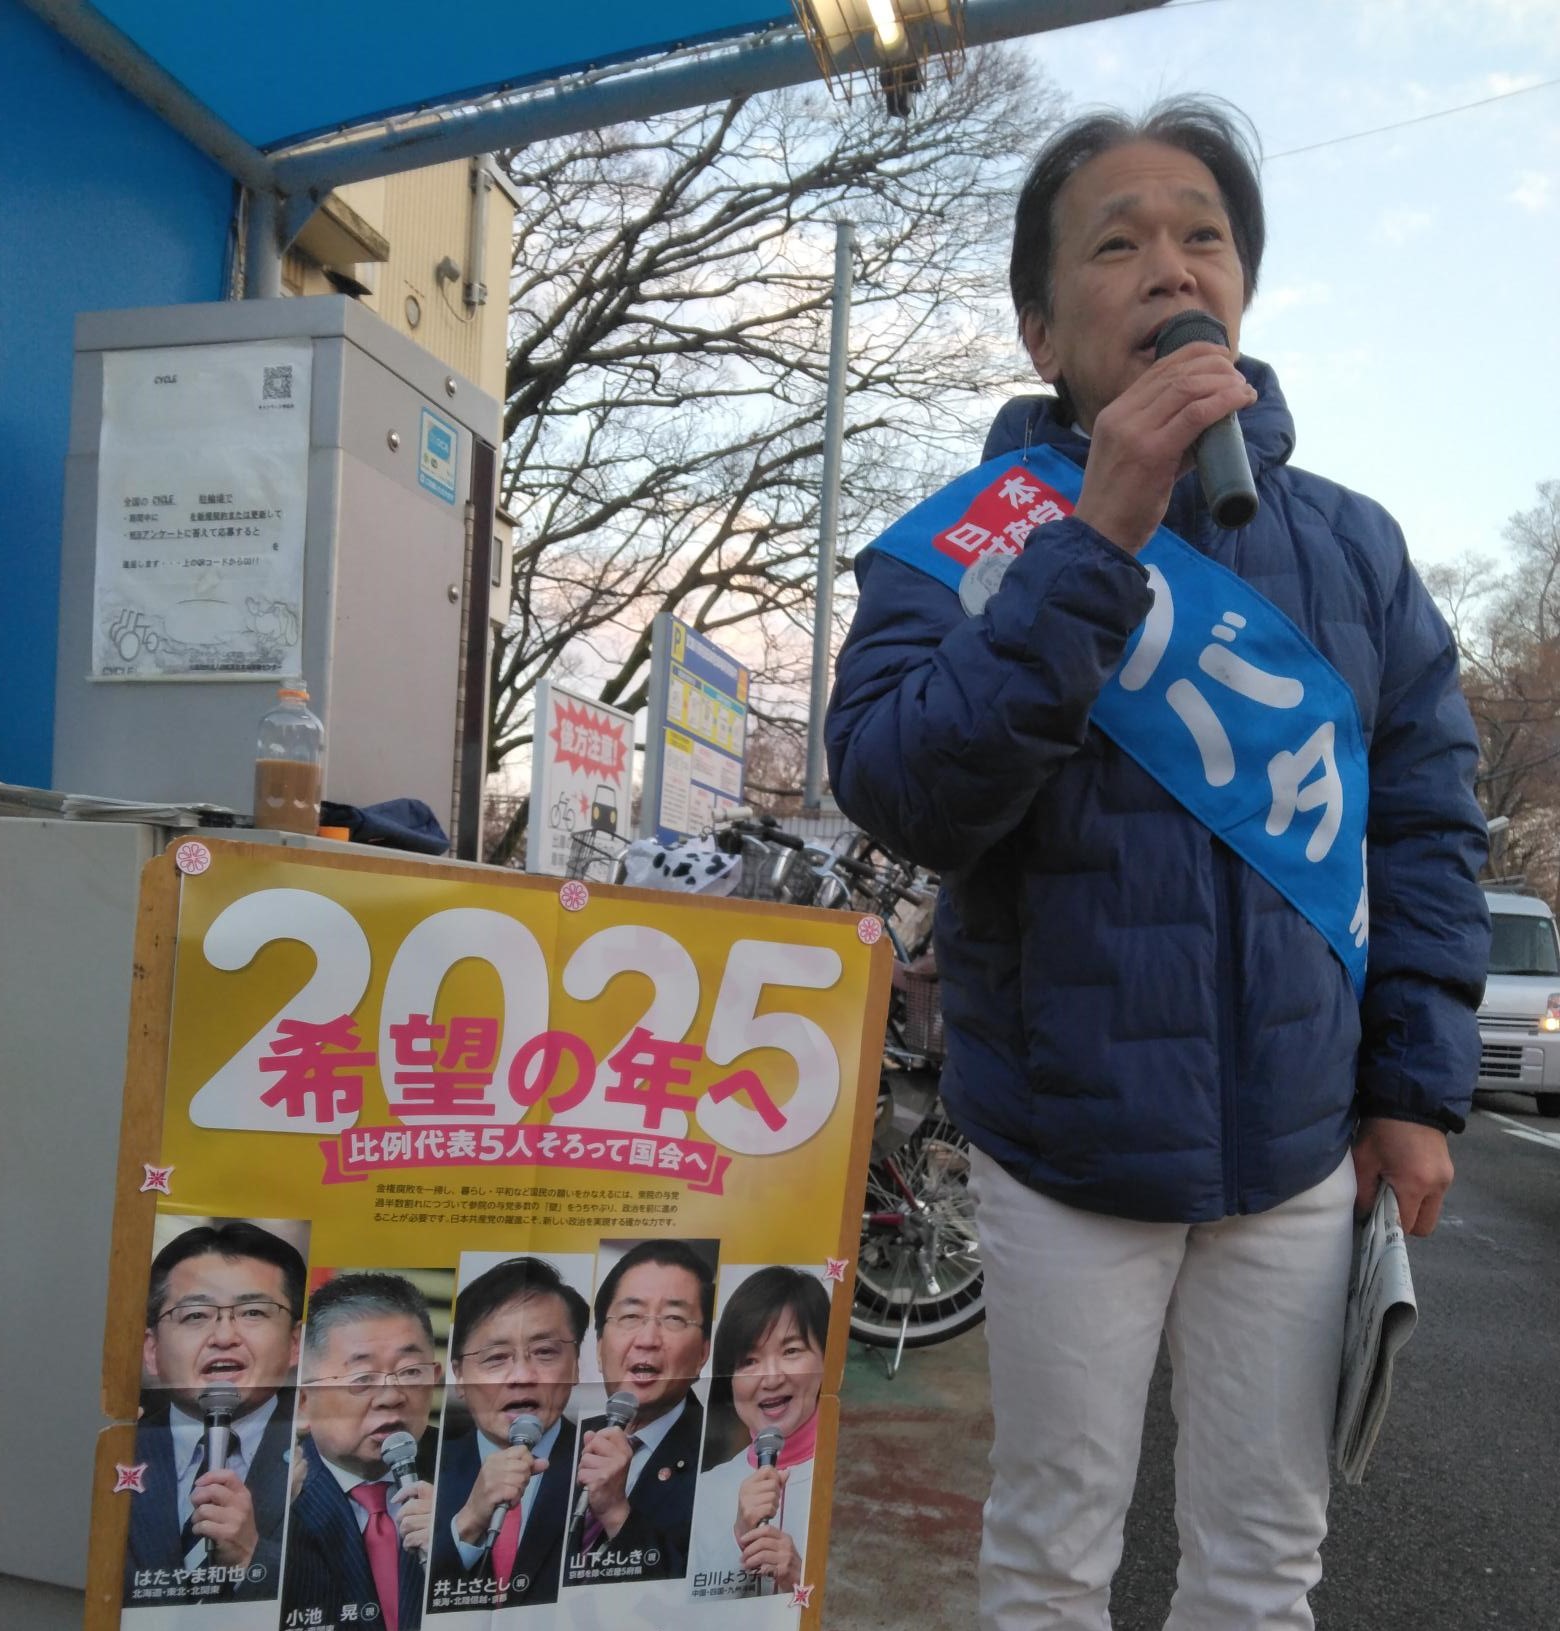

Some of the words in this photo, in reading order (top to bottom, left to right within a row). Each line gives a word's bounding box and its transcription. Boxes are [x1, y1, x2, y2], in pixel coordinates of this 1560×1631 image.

[188, 888, 843, 1156] 2025
[257, 1012, 789, 1133] 希望の年へ
[348, 1128, 708, 1171] 比例代表5人そろって国会へ
[570, 1549, 642, 1569] 山下よしき
[134, 1566, 246, 1586] はたやま和也
[433, 1576, 511, 1597] 井上さとし
[286, 1606, 322, 1627] 小池
[340, 1603, 358, 1622] 晃
